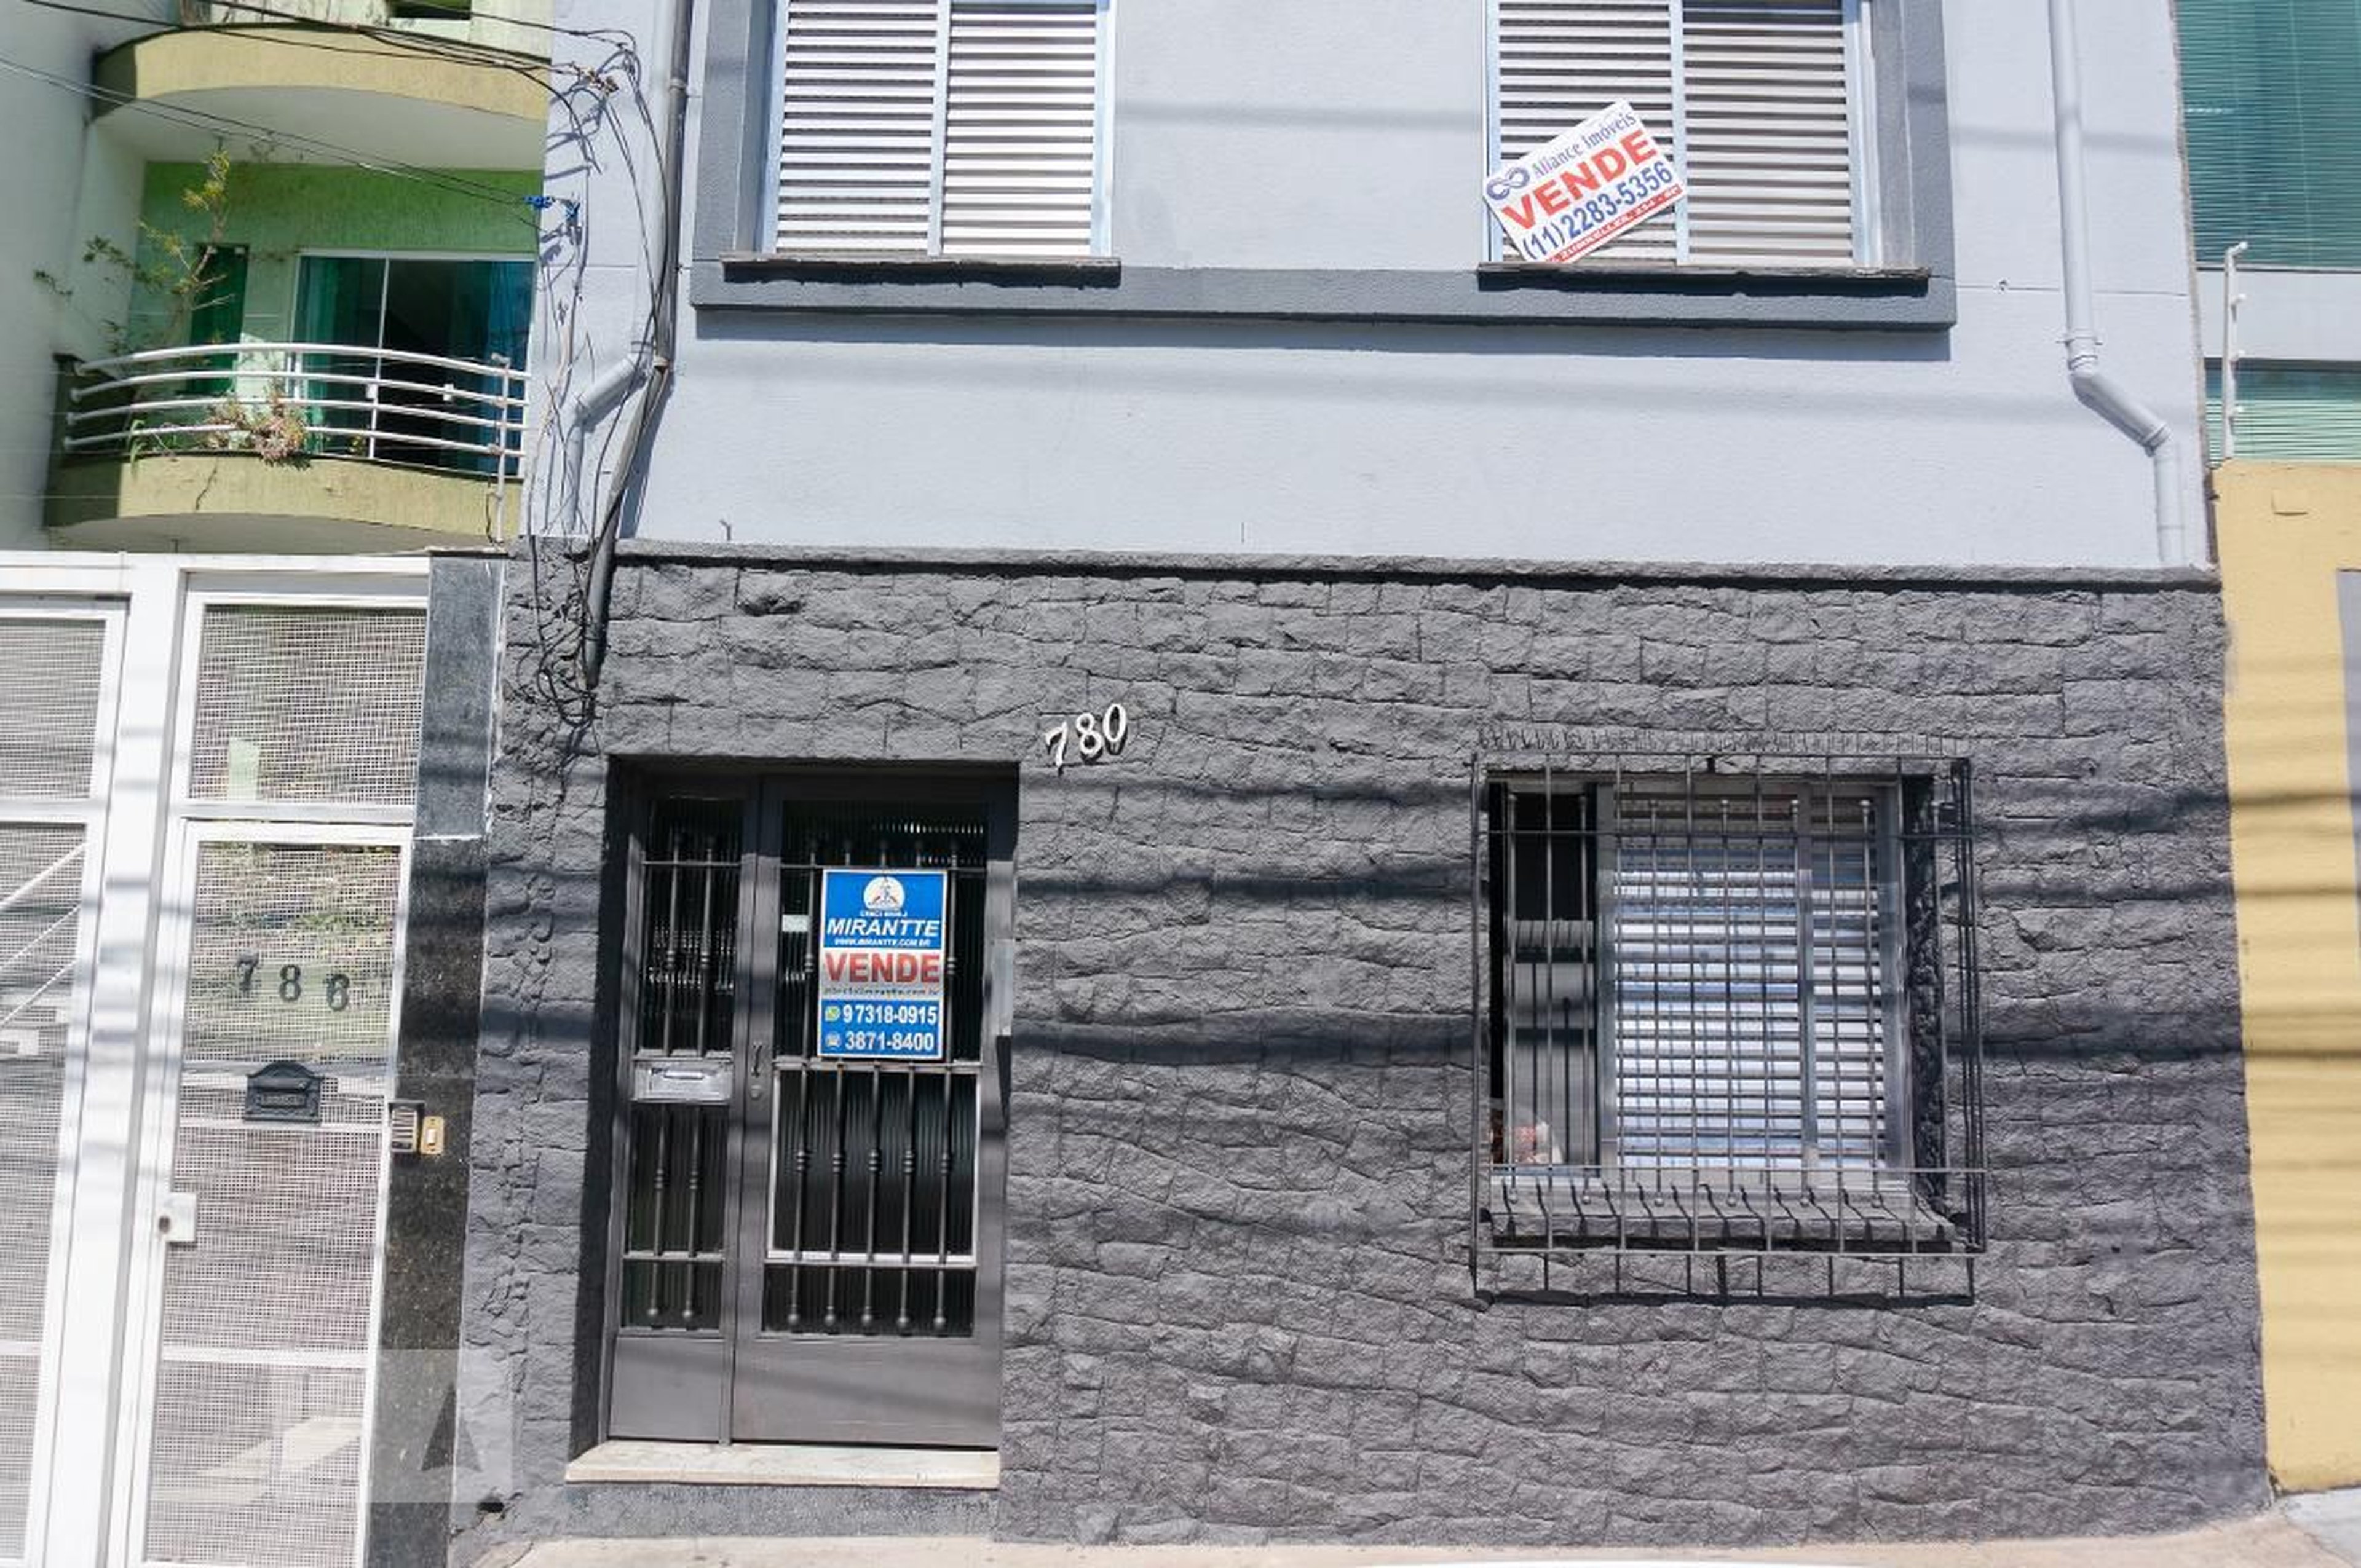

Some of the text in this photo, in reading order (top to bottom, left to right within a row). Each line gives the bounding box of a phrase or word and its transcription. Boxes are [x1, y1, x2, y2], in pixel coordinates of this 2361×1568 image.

[1502, 130, 1658, 230] VENDE
[1045, 703, 1127, 766] 780
[827, 918, 940, 937] MIRANTTE
[824, 953, 940, 983] VENDE
[845, 1031, 934, 1051] 3871-8400
